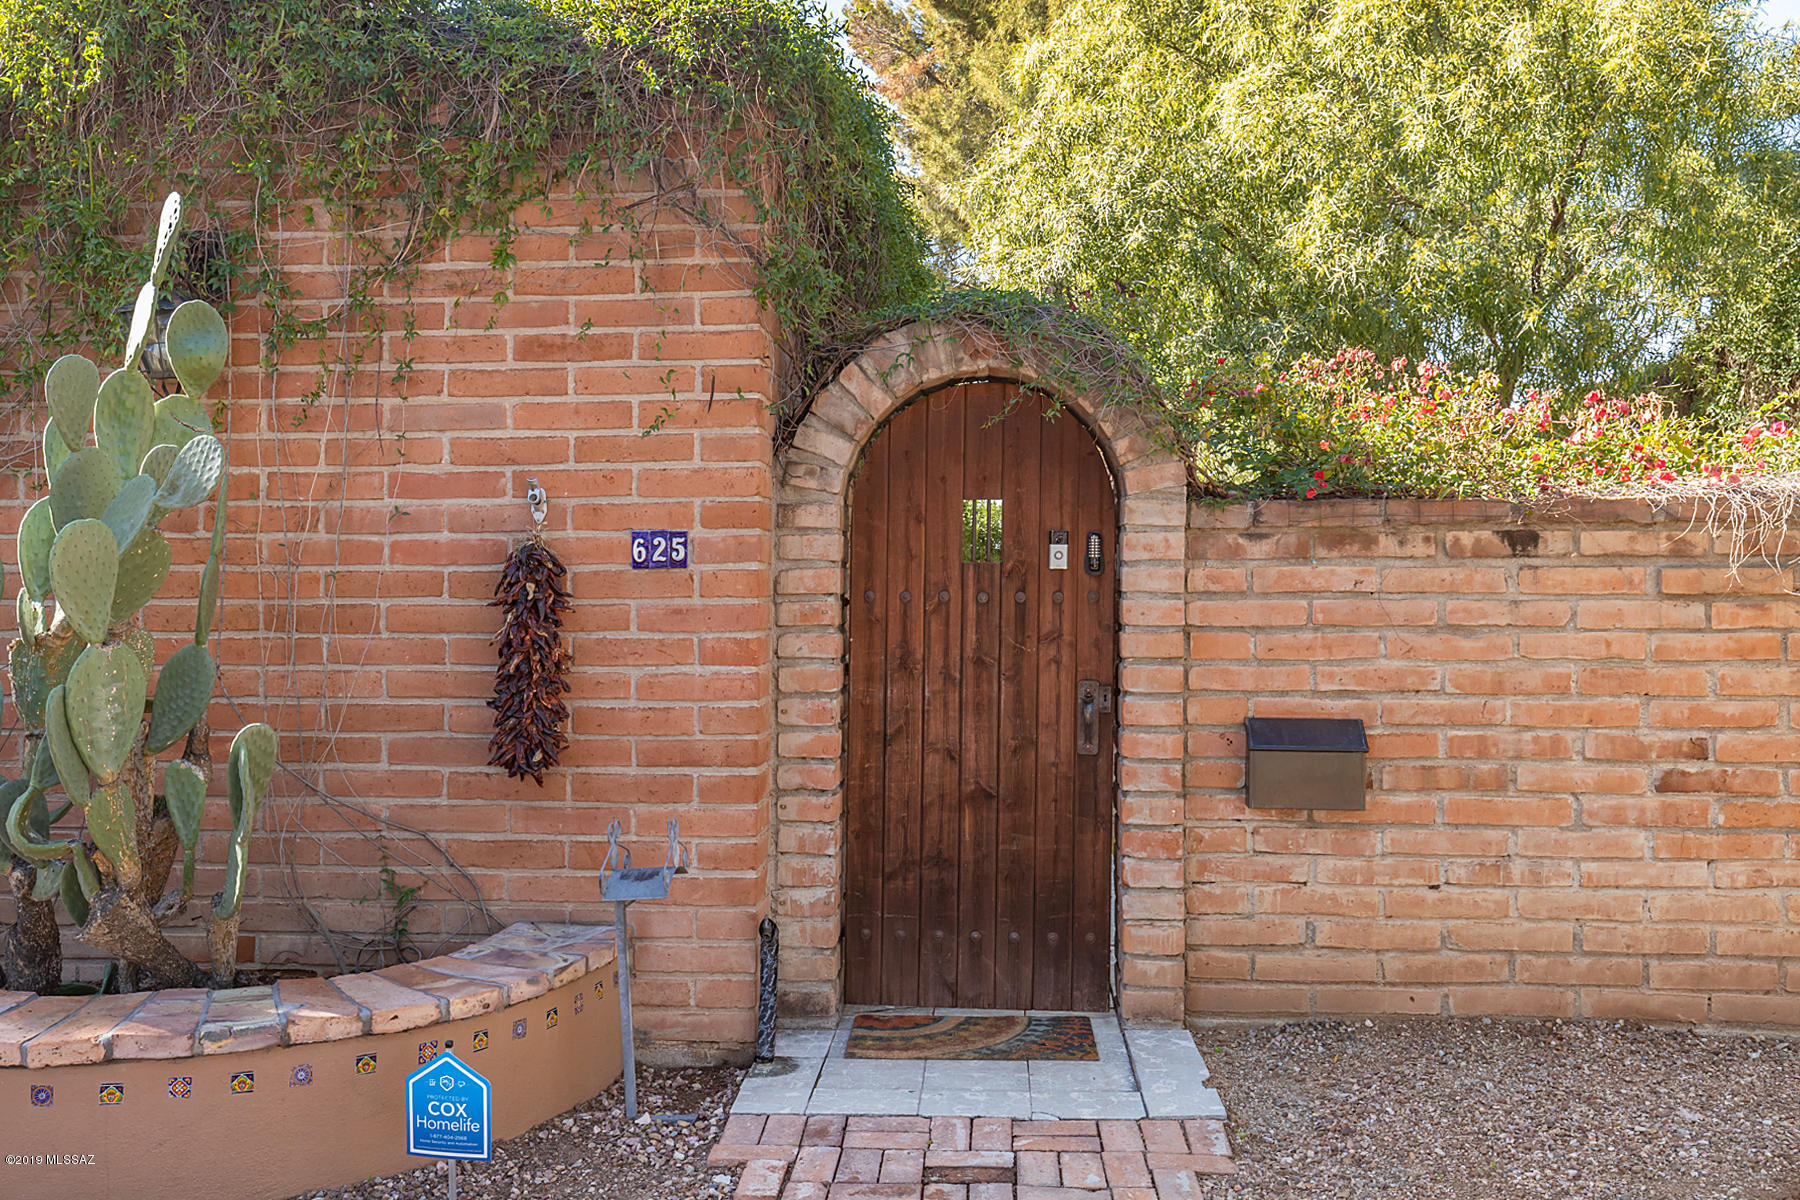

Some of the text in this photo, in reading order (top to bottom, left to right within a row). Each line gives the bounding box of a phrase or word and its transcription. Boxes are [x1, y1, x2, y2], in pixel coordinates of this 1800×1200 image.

[633, 537, 685, 562] 625
[426, 1094, 459, 1102] PROTECTED
[428, 1101, 467, 1118] COX
[416, 1114, 480, 1132] Homelife
